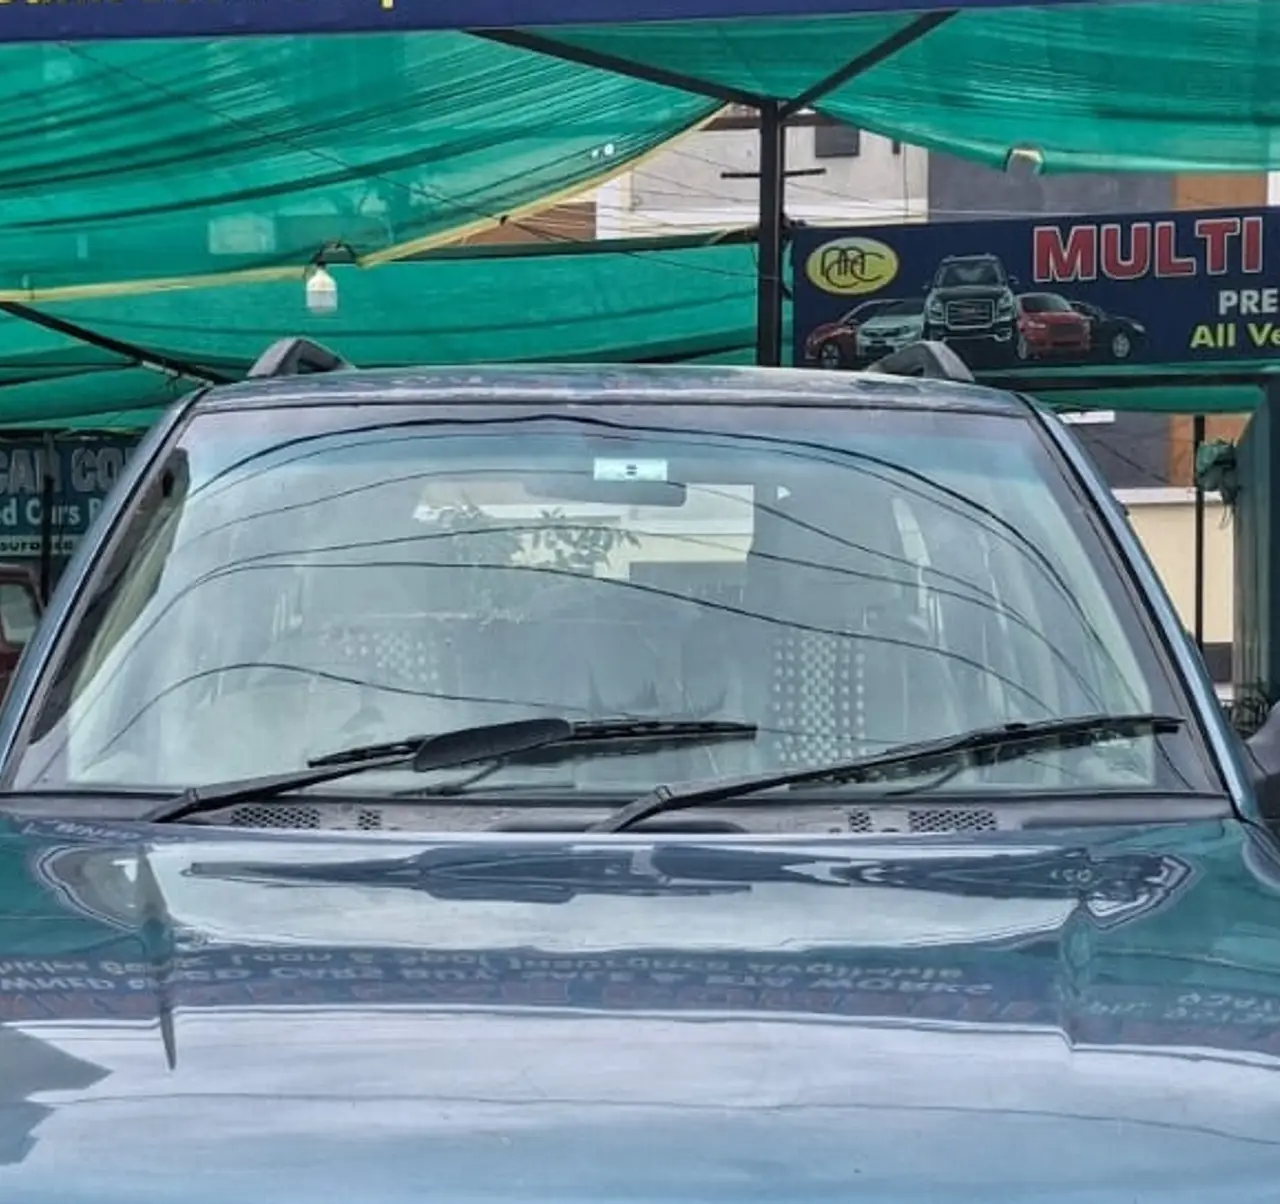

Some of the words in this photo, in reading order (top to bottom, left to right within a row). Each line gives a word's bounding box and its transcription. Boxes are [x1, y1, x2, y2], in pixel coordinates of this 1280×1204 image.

[1032, 216, 1263, 283] MULTI
[1189, 322, 1237, 349] All
[71, 446, 134, 494] CO
[25, 499, 82, 526] Crs
